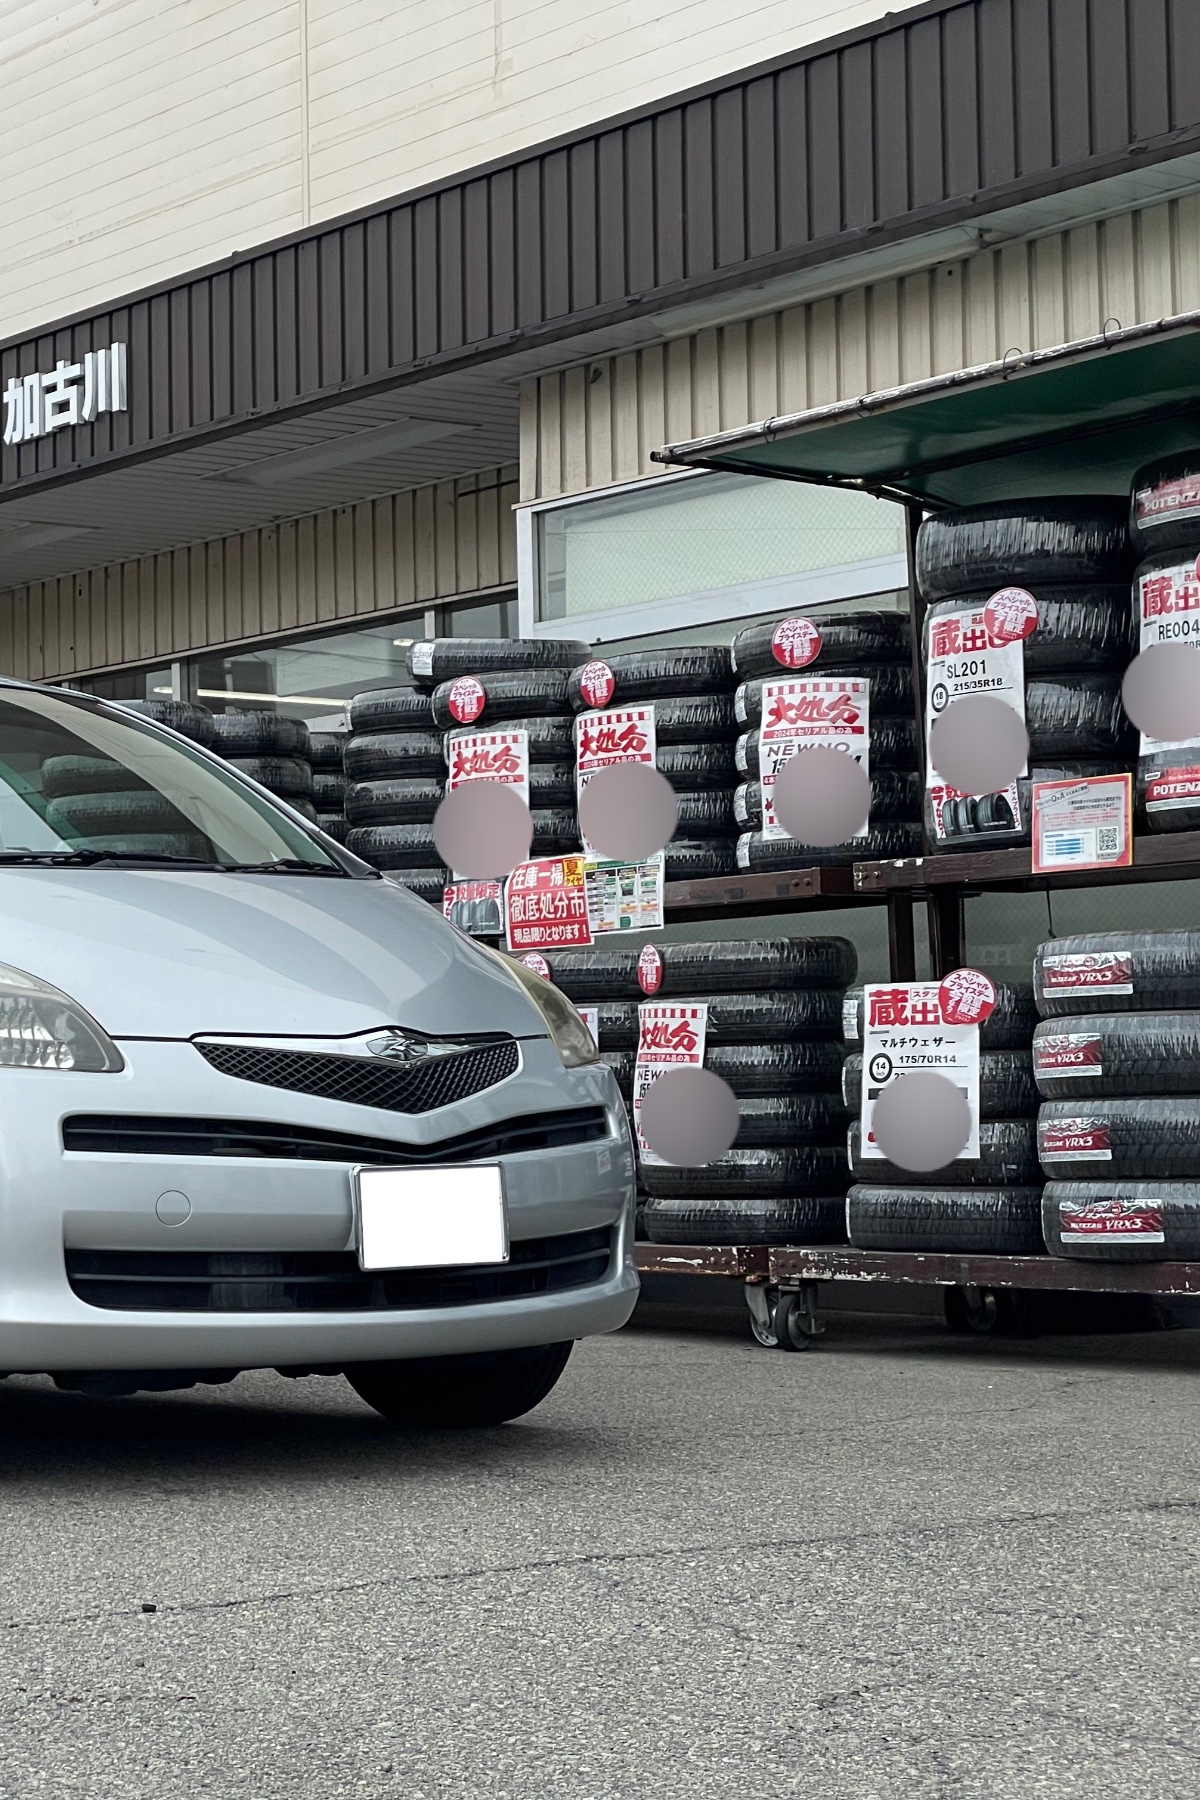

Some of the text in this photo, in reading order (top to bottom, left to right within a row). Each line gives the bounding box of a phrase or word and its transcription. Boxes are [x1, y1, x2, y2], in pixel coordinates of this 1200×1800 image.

[3, 341, 127, 446] 加古川
[947, 660, 986, 679] SL201
[954, 678, 1003, 692] 215/35R18
[935, 691, 944, 700] 18
[765, 694, 861, 728] 大処分
[579, 722, 648, 760] 大処分
[452, 745, 521, 779] 大処分
[565, 858, 581, 876] 夏
[512, 863, 563, 890] 在庫一掃
[565, 876, 583, 886] タイヤ
[510, 890, 585, 923] 徹底処分市
[1080, 971, 1113, 983] VRX3
[868, 988, 962, 1027] 蔵出
[640, 1020, 699, 1052] 大処分
[880, 1036, 956, 1048] マルチウェザー
[899, 1055, 956, 1064] 175/70R14
[1057, 1052, 1084, 1063] VRX3
[875, 1062, 886, 1070] 14
[638, 1069, 669, 1081] NEW
[1065, 1136, 1093, 1148] VRX3
[1105, 1218, 1142, 1230] VRX3
